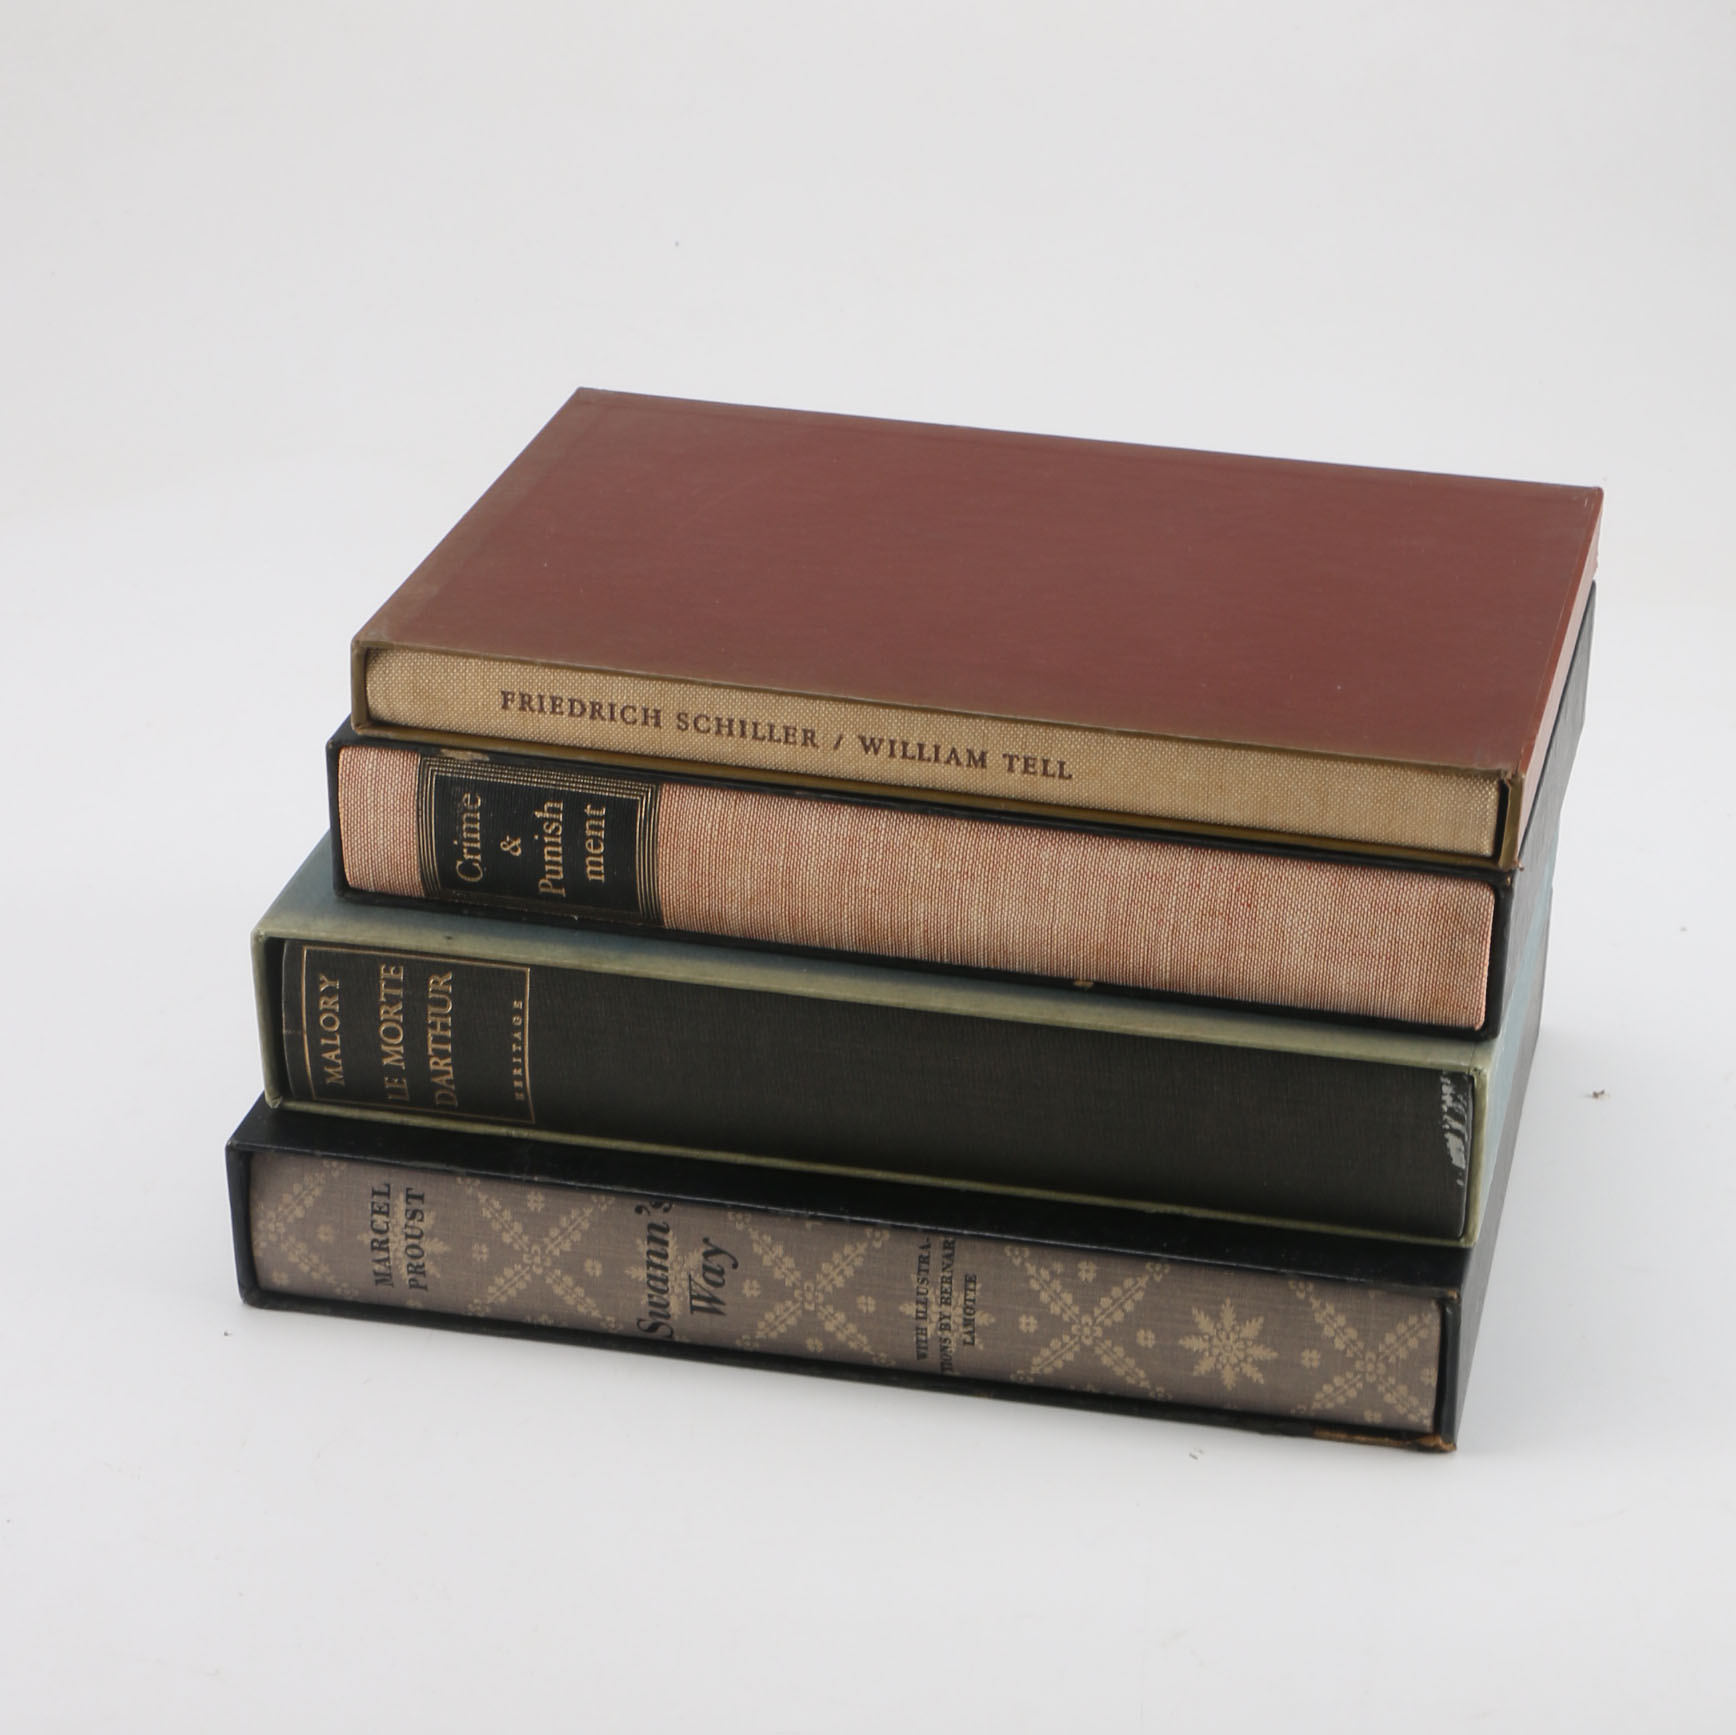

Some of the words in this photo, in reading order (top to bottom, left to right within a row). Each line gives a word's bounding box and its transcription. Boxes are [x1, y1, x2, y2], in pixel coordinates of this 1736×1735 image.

[500, 690, 662, 728] FRIEDRICH
[675, 711, 819, 749] SCHILLER
[858, 734, 988, 769] WILLIAM
[1003, 753, 1073, 780] TELL
[455, 792, 484, 882] Crime
[500, 835, 522, 857] &
[534, 800, 566, 898] Punish
[584, 803, 606, 883] ment
[319, 972, 346, 1086] MALORY
[378, 963, 404, 1070] MORTE
[427, 971, 458, 1108] DARTHUR
[511, 999, 526, 1101] HERITAGE
[384, 1075, 409, 1101] LE
[370, 1182, 394, 1288] MARCEL
[405, 1187, 428, 1292] PROUST
[688, 1237, 739, 1316] Way
[915, 1236, 932, 1321] ILLUSTRA-
[940, 1238, 956, 1306] BERNAR
[915, 1326, 929, 1360] WITH
[938, 1311, 952, 1332] BY
[963, 1272, 977, 1346] LAMOTTE
